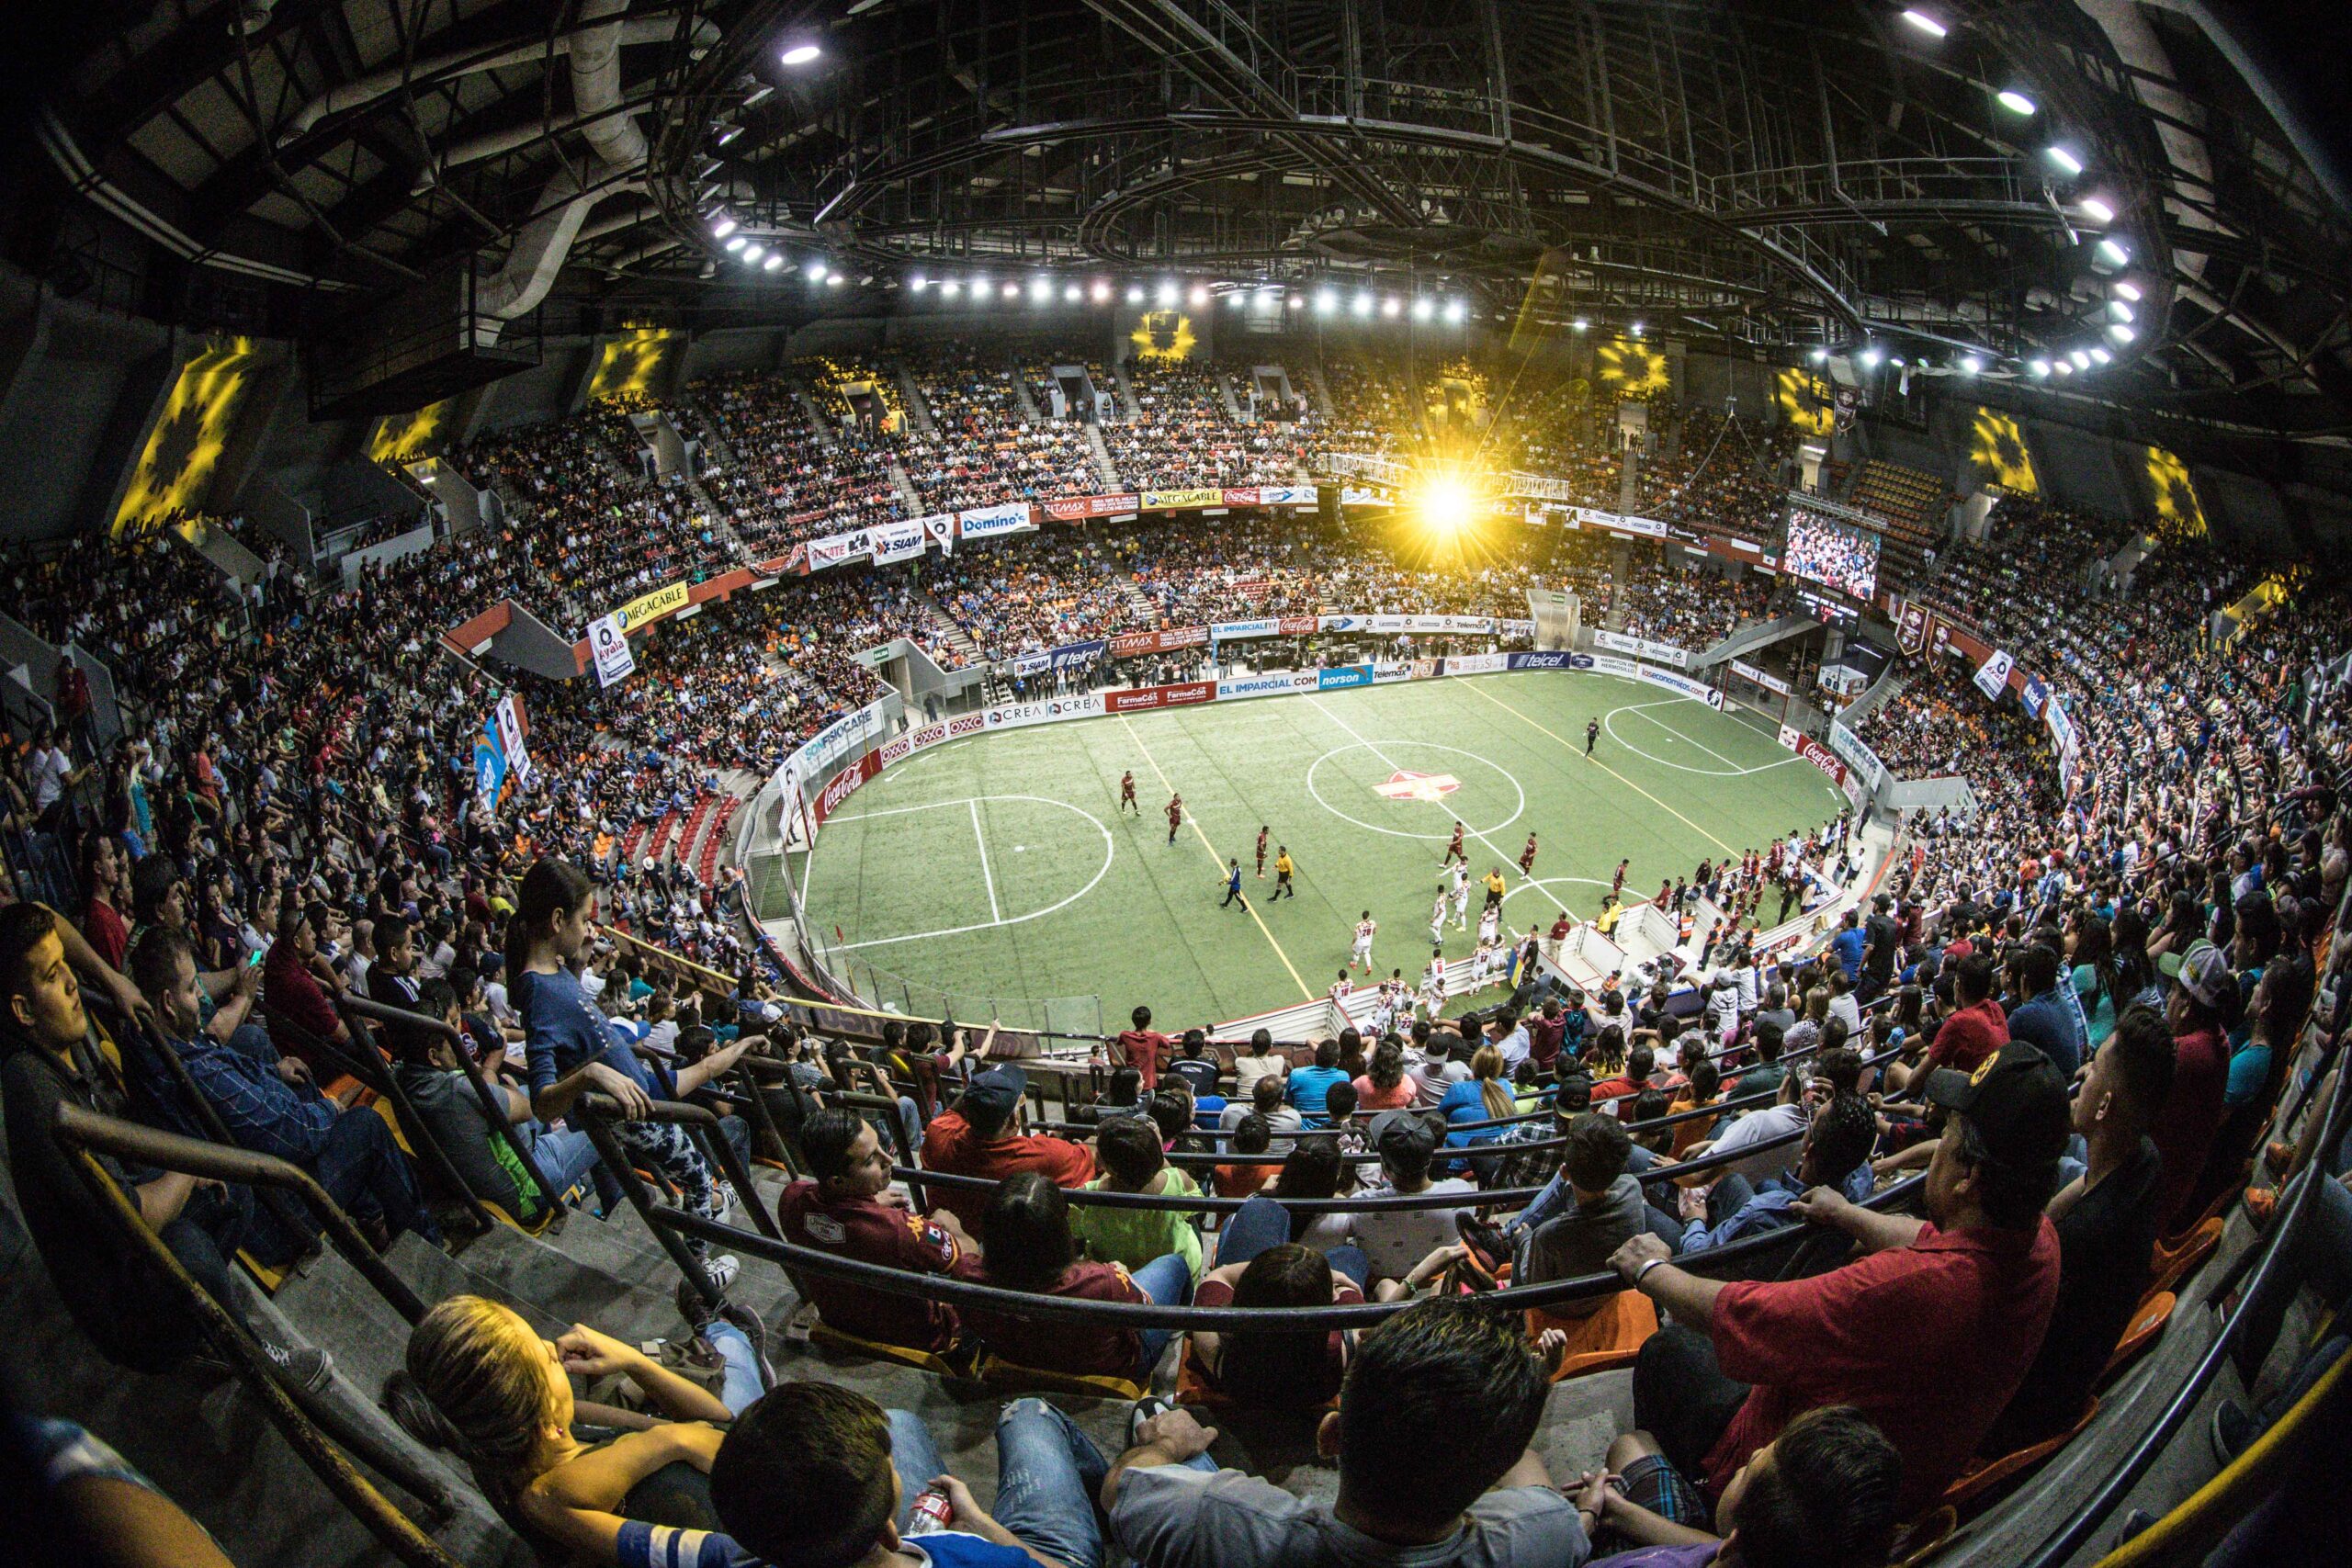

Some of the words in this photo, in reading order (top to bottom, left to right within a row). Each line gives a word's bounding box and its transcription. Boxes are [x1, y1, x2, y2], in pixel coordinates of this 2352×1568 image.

[1159, 492, 1217, 504] MEGACABLE
[964, 513, 1027, 532] Domino's
[892, 536, 922, 550] SIAM
[628, 588, 683, 621] MEGACABLE
[1224, 624, 1265, 633] IMPARCIAL
[599, 639, 625, 660] Ayala
[1109, 635, 1153, 650] FITMAX
[1027, 660, 1048, 671] SIAM
[1526, 653, 1565, 668] telcel
[1600, 657, 1627, 667] HAMPTON
[1374, 669, 1407, 679] Telemax
[1600, 662, 1634, 674] HERMOSILLO
[1322, 674, 1359, 685] norson
[1220, 684, 1233, 694] EL
[1003, 705, 1041, 719] CREA
[1062, 698, 1101, 712] CREA
[914, 726, 944, 746] OXXO
[882, 741, 909, 762] OXXO
[1804, 742, 1841, 779] Coca-Cola
[824, 760, 863, 815] Coca-Cola
